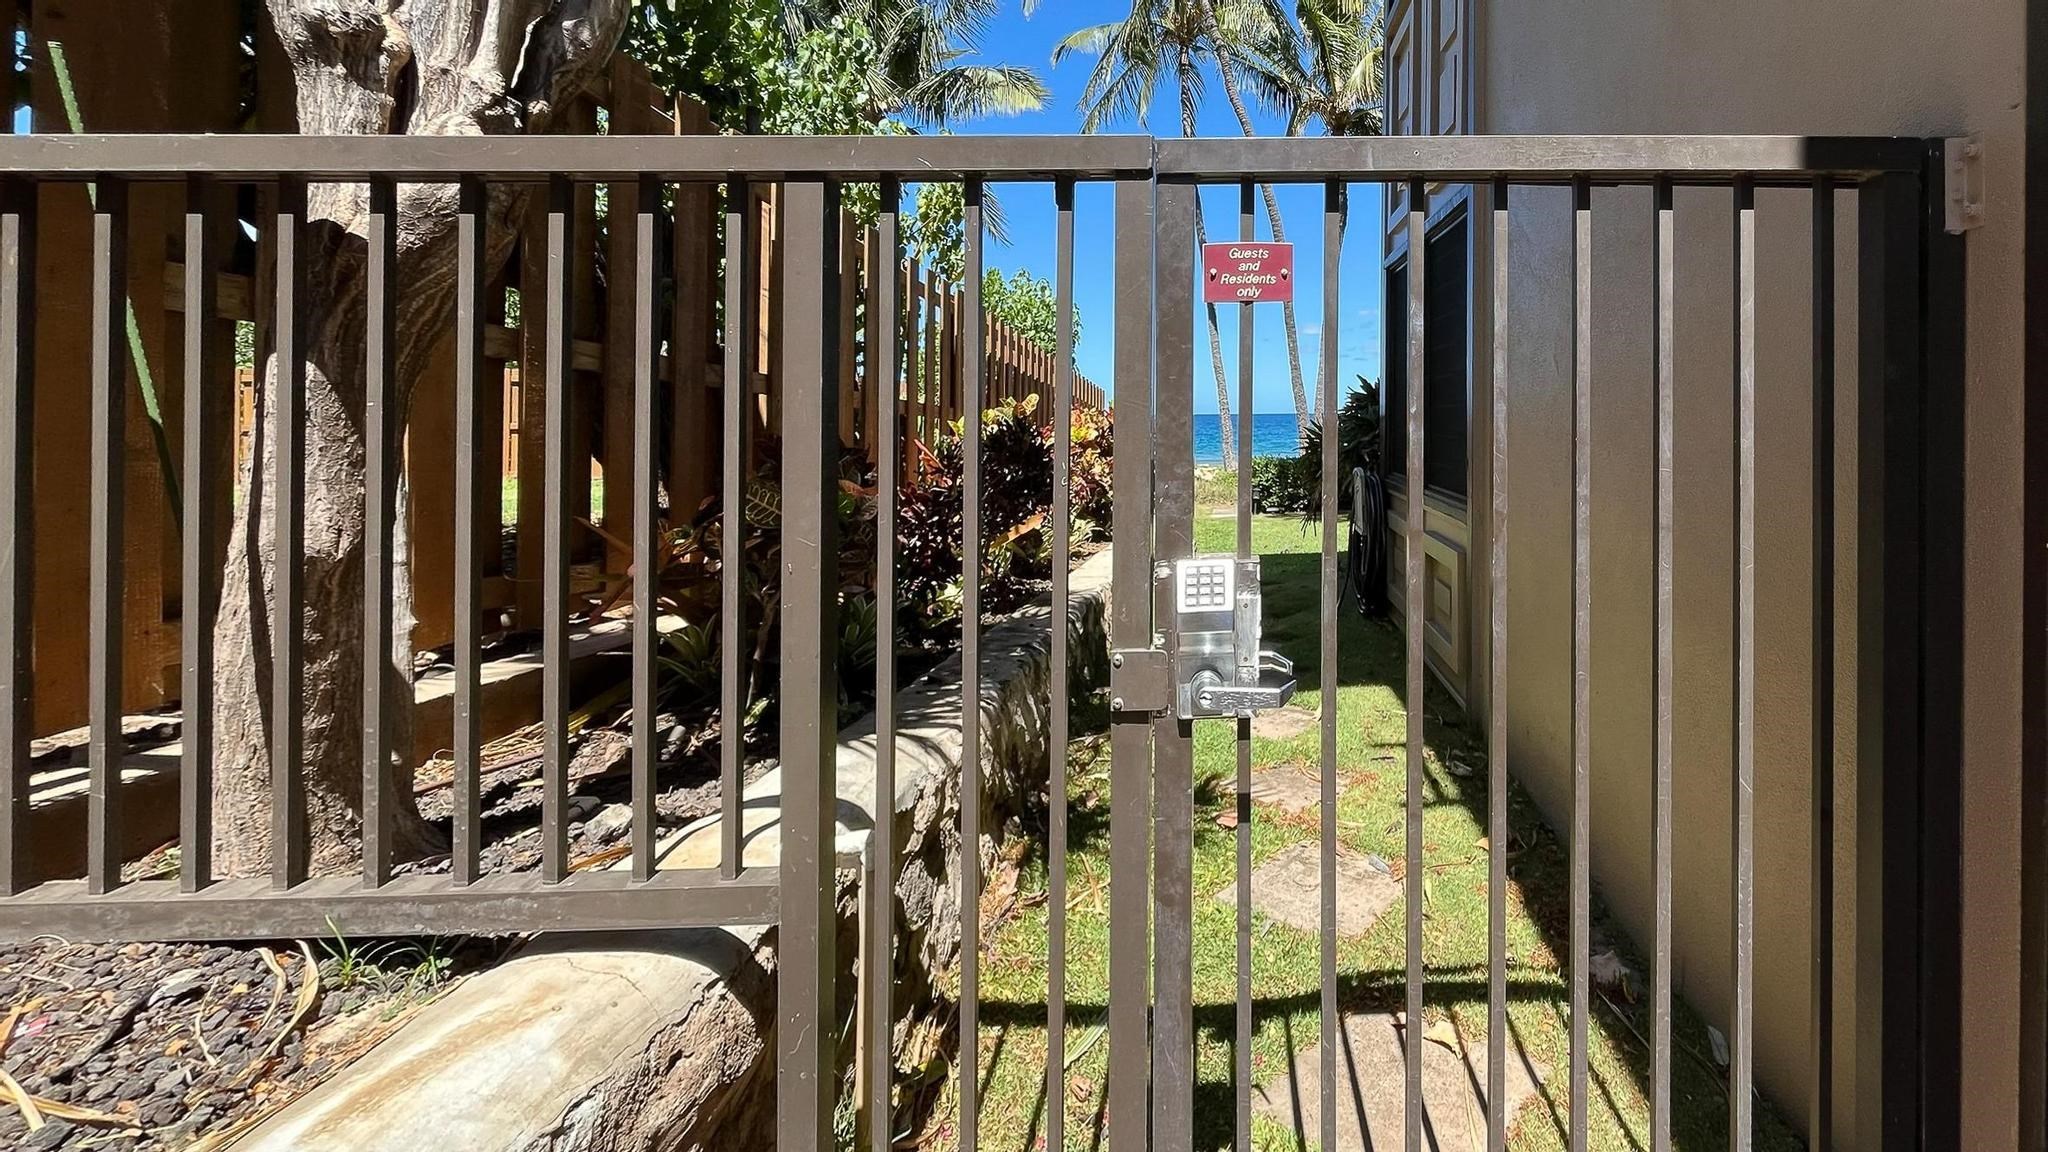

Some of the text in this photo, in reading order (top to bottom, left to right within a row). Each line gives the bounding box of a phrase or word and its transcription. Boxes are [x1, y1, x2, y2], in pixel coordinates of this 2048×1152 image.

[1229, 247, 1269, 259] Guests
[1238, 261, 1261, 271] and
[1220, 273, 1277, 285] Residents
[1236, 286, 1262, 298] only
